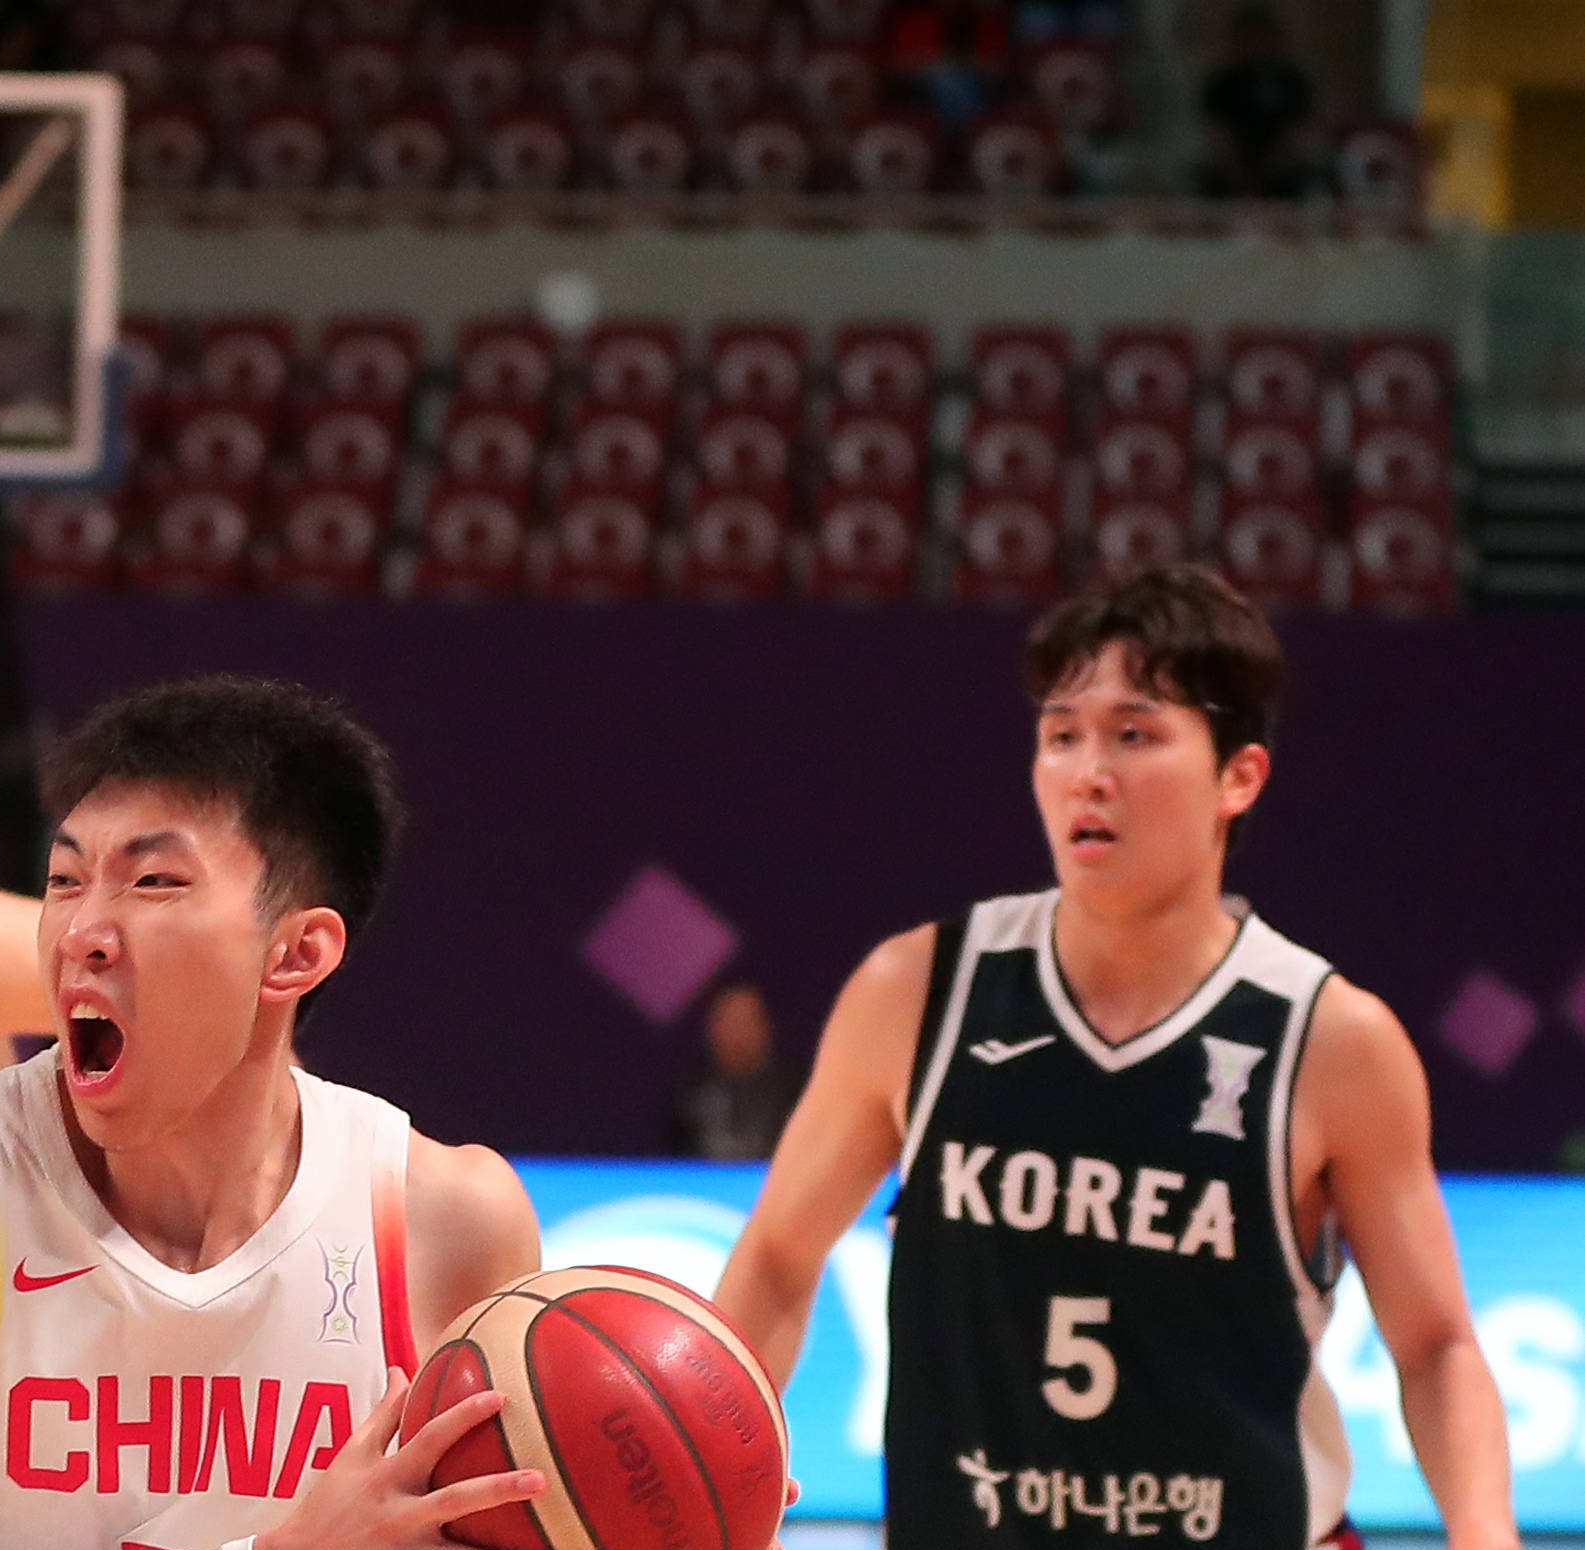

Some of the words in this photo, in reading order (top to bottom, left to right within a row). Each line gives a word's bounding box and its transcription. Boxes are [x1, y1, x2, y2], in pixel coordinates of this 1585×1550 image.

[939, 1140, 1237, 1261] KOREA
[1040, 1295, 1119, 1422] 5
[5, 1374, 354, 1500] CHINA
[1016, 1467, 1224, 1541] 하나은행
